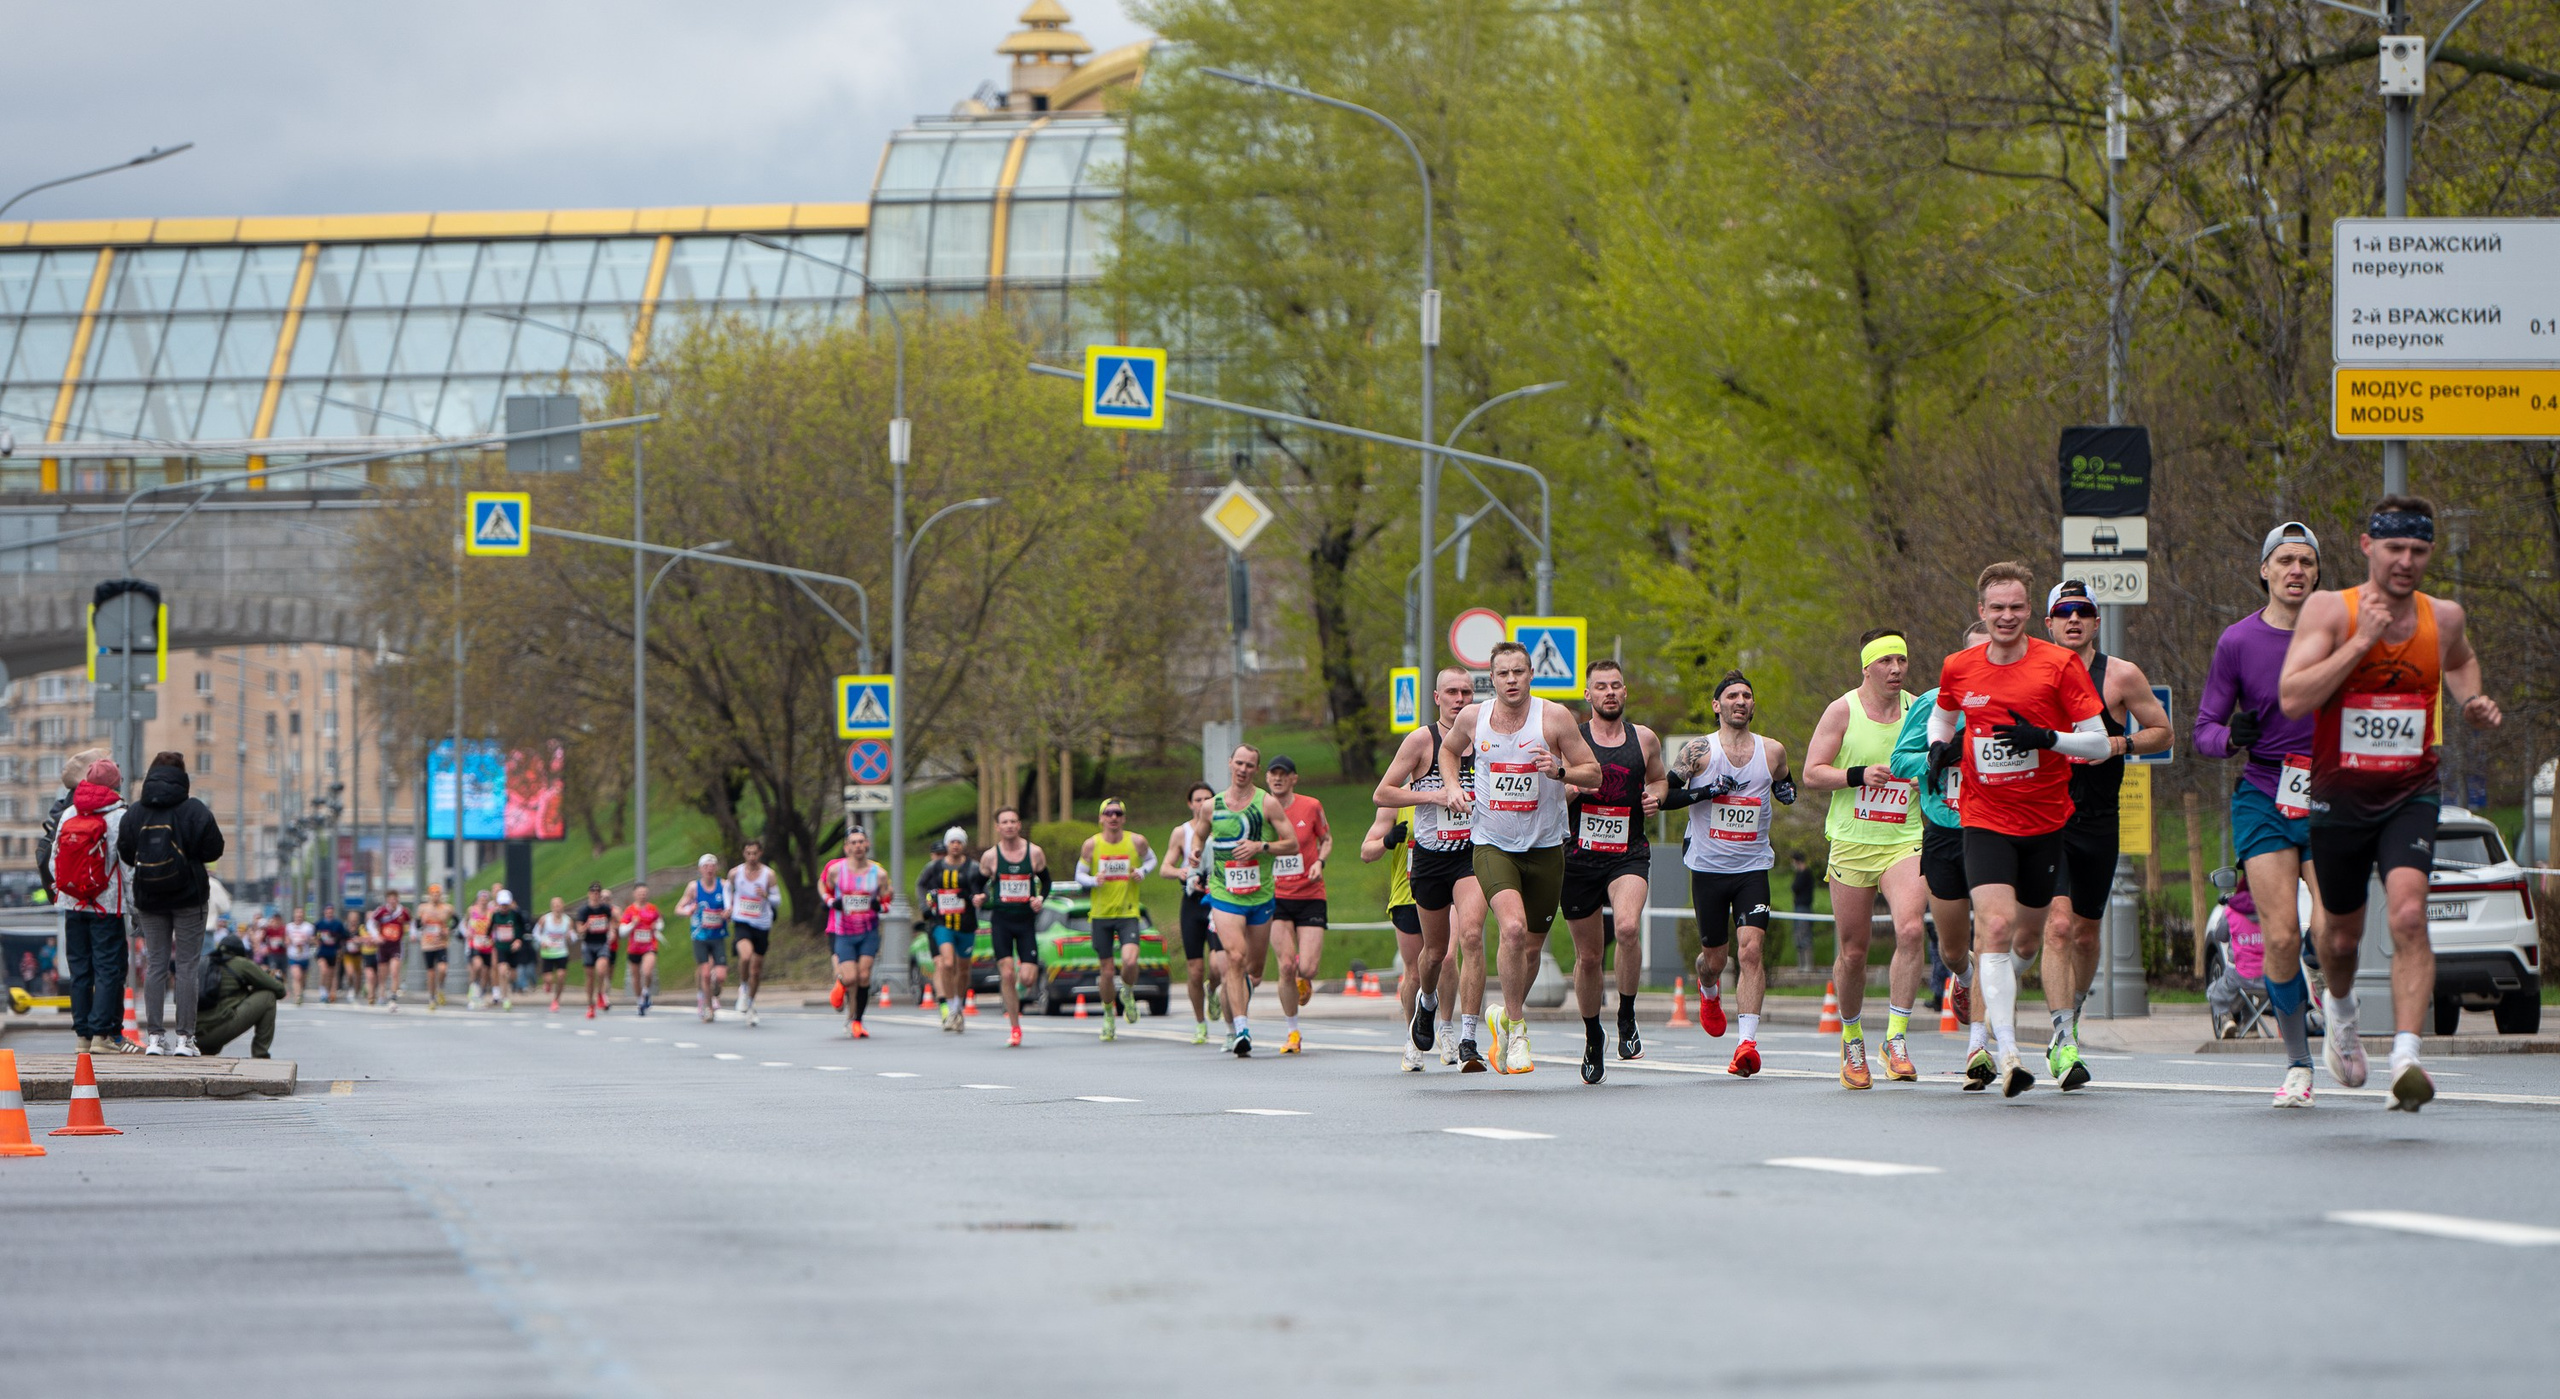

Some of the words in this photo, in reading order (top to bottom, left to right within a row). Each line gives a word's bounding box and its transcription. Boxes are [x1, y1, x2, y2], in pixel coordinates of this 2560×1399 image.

[2352, 236, 2382, 252] 1-й
[2388, 232, 2502, 252] ВРАЖСКИЙ
[2352, 261, 2445, 277] переулок
[2352, 307, 2382, 324] 2-й
[2388, 304, 2502, 324] ВРАЖСКИЙ
[2530, 319, 2556, 334] 0.1
[2352, 333, 2445, 349] переулок
[2351, 381, 2423, 399] МОДУС
[2430, 384, 2520, 400] ресторан
[2531, 395, 2558, 411] 0.4
[2351, 406, 2424, 423] MODUS
[2113, 573, 2137, 592] 20
[2354, 716, 2415, 739] 3894
[1495, 776, 1532, 792] 4749
[1859, 785, 1908, 805] 17776
[1719, 808, 1755, 823] 1902
[1586, 817, 1623, 834] 5795
[1229, 869, 1256, 881] 9516
